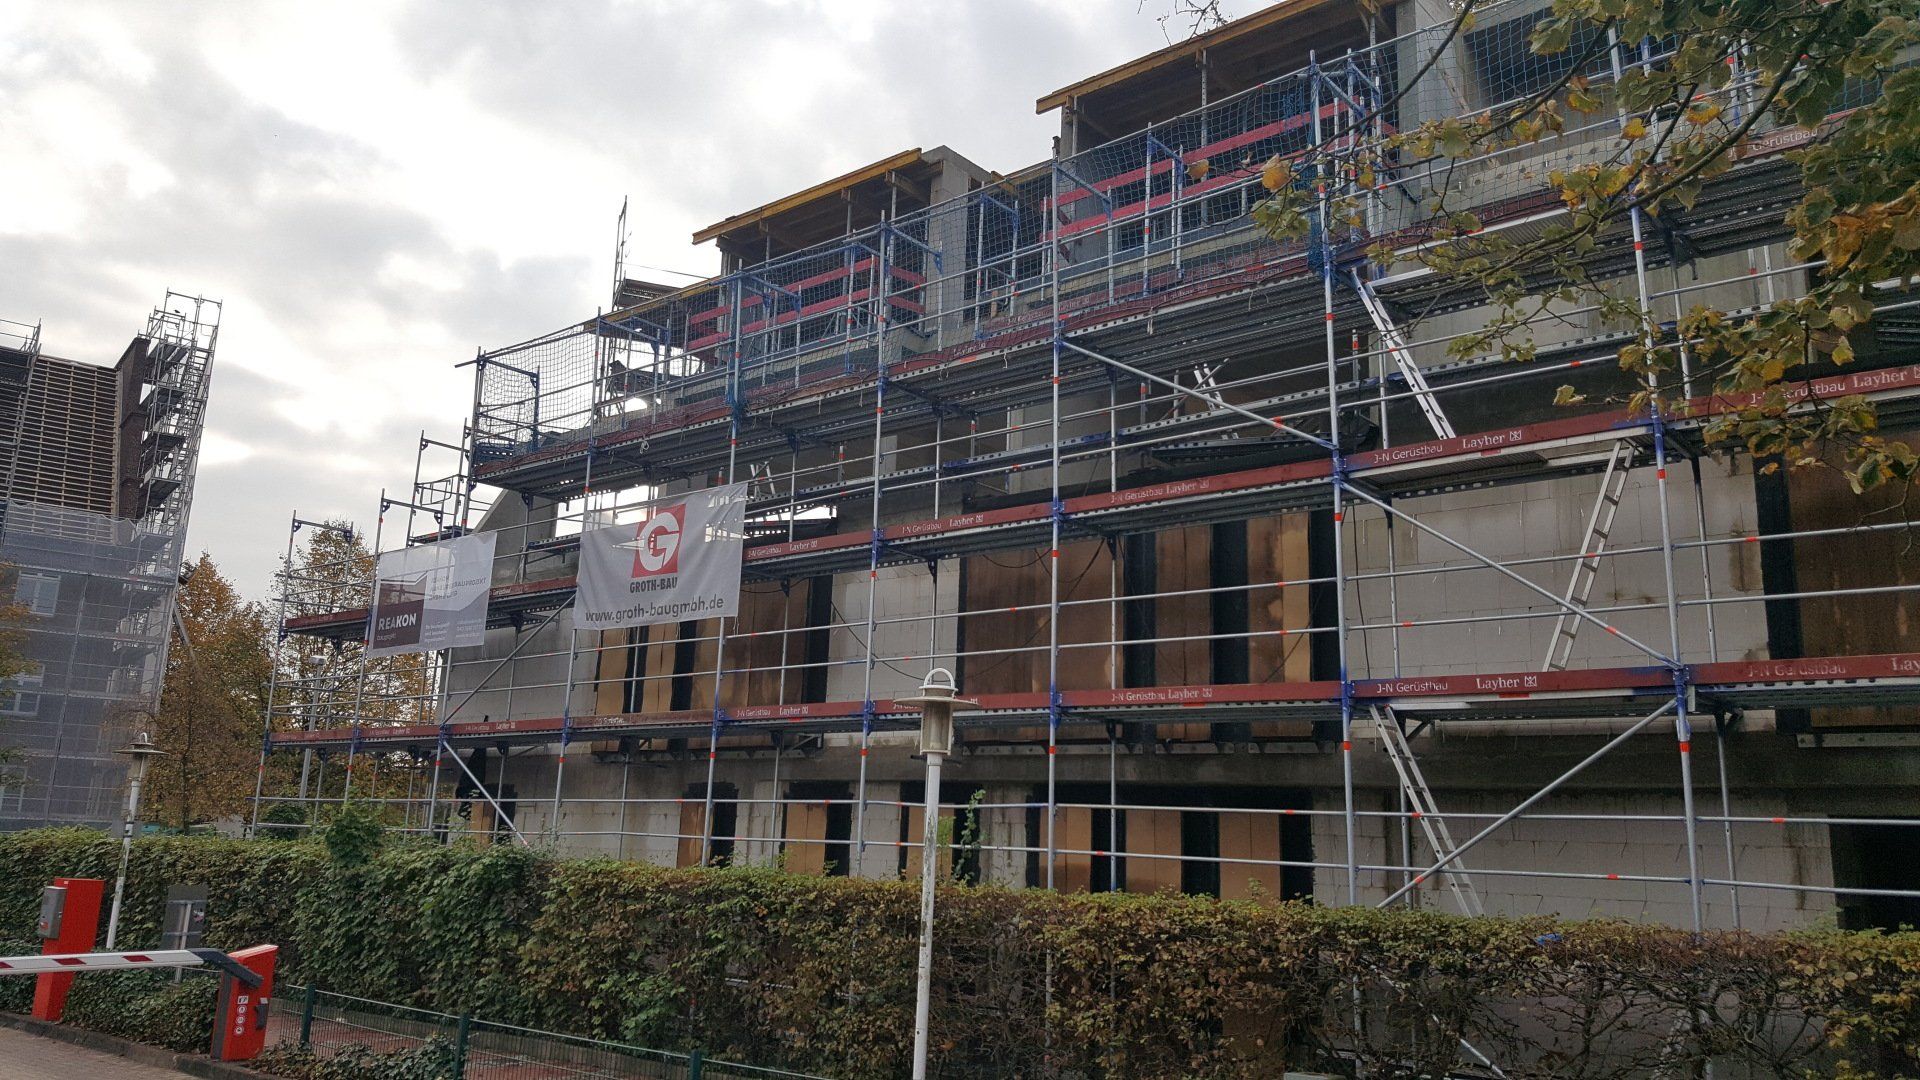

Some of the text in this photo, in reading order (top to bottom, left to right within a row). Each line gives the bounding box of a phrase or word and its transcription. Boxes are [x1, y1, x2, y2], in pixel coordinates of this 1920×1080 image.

[1852, 370, 1909, 389] Layher
[1374, 433, 1506, 465] J-N Gerüstbau Layher
[629, 577, 678, 594] GROTH-BAU
[585, 593, 724, 624] www.groth-baugmbh.de
[378, 612, 418, 631] REAKON
[1376, 676, 1520, 694] J-N Gerüstbau Layher
